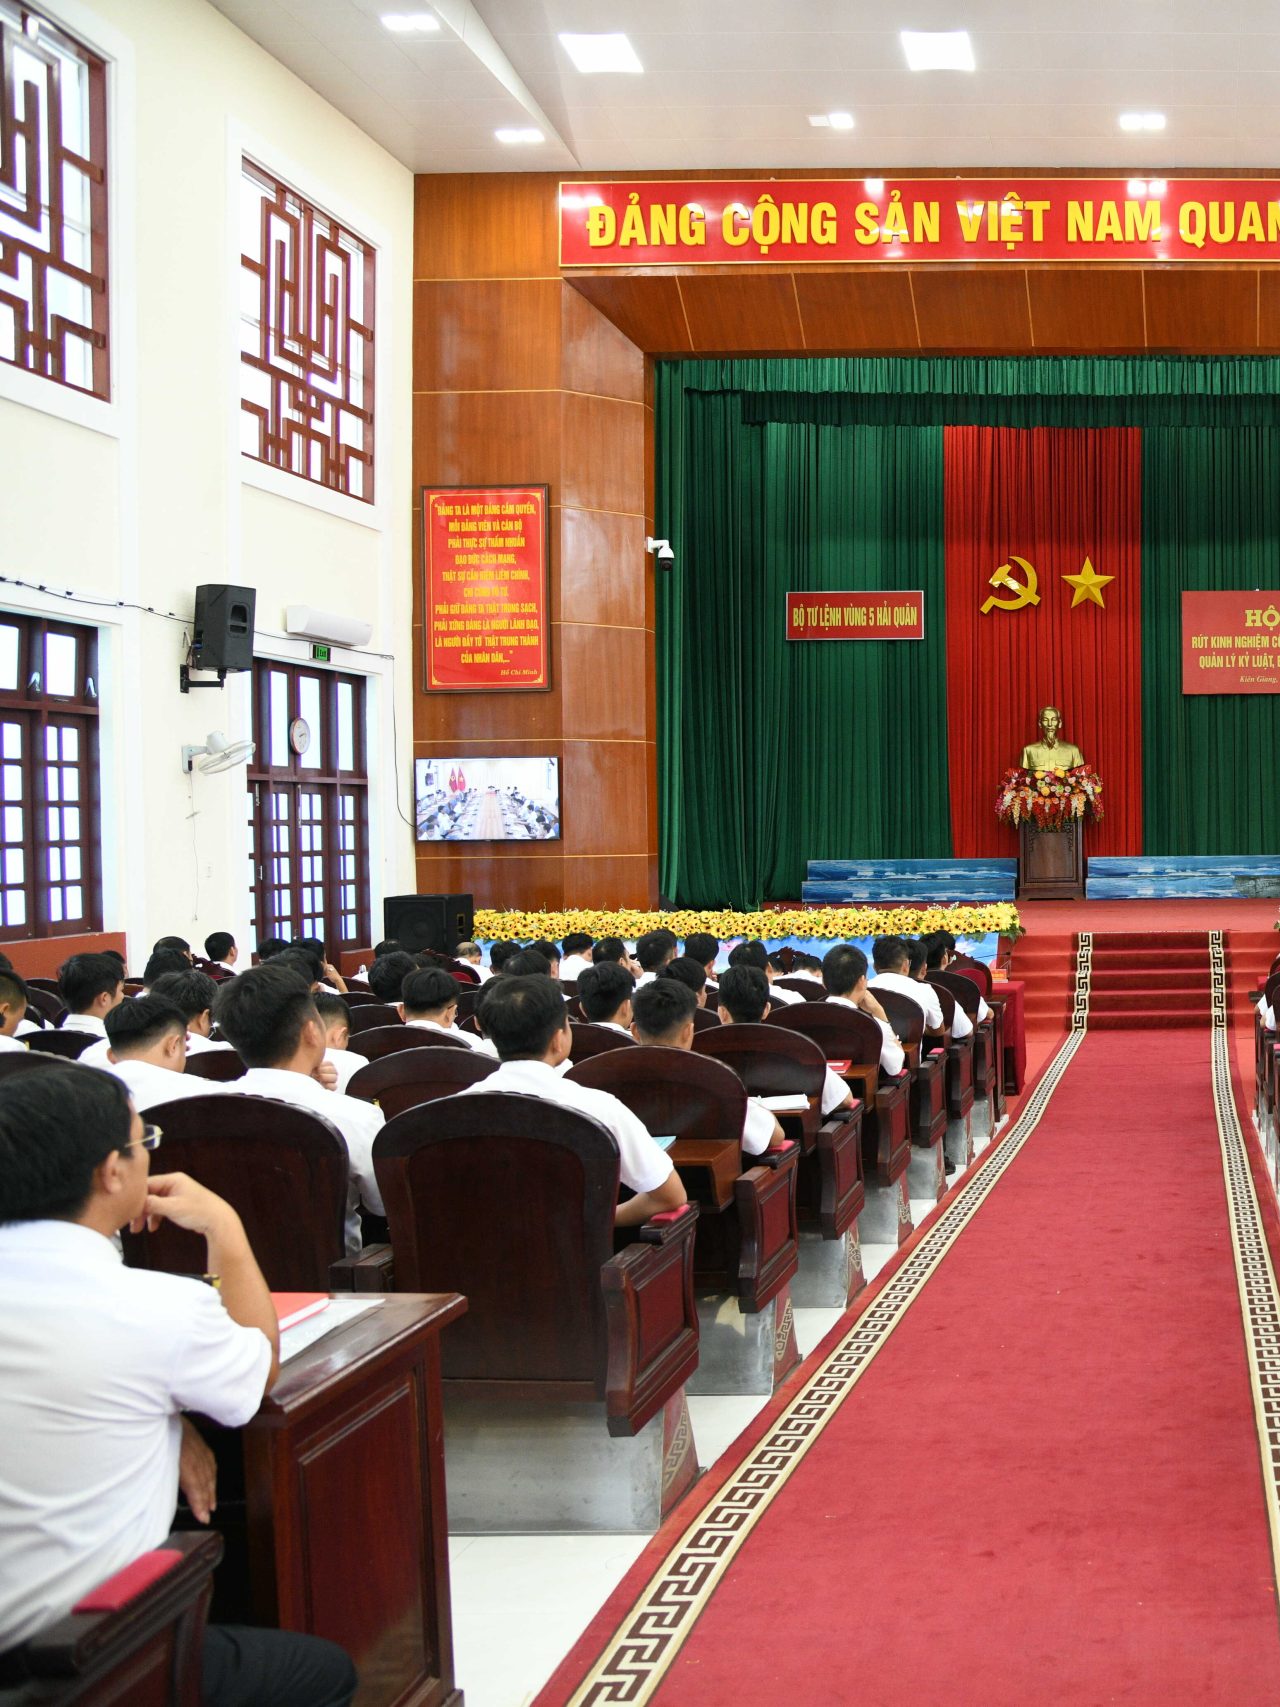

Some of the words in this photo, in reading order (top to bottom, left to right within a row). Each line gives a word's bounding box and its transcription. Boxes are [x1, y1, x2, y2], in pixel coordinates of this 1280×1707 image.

[586, 192, 706, 246] ĐẢNG
[721, 193, 837, 254] CỘNG
[855, 189, 940, 246] SẢN
[956, 191, 1051, 251] VIỆT
[1067, 200, 1162, 244] NAM
[793, 604, 805, 631] BỘ
[807, 606, 818, 626] TƯ
[820, 603, 841, 630] LỆNH
[844, 603, 866, 626] VÙNG
[869, 607, 874, 626] 5
[877, 600, 891, 626] HẢI
[894, 603, 917, 628] QUÂN
[1192, 634, 1208, 648] RÚT
[1211, 636, 1232, 648] KINH
[1235, 634, 1269, 650] NGHIỆM
[1199, 652, 1223, 669] QUẢN
[1226, 653, 1236, 667] LÝ
[1238, 651, 1250, 667] KỶ
[1252, 653, 1275, 670] LUẬT,
[1257, 675, 1278, 684] Giang,
